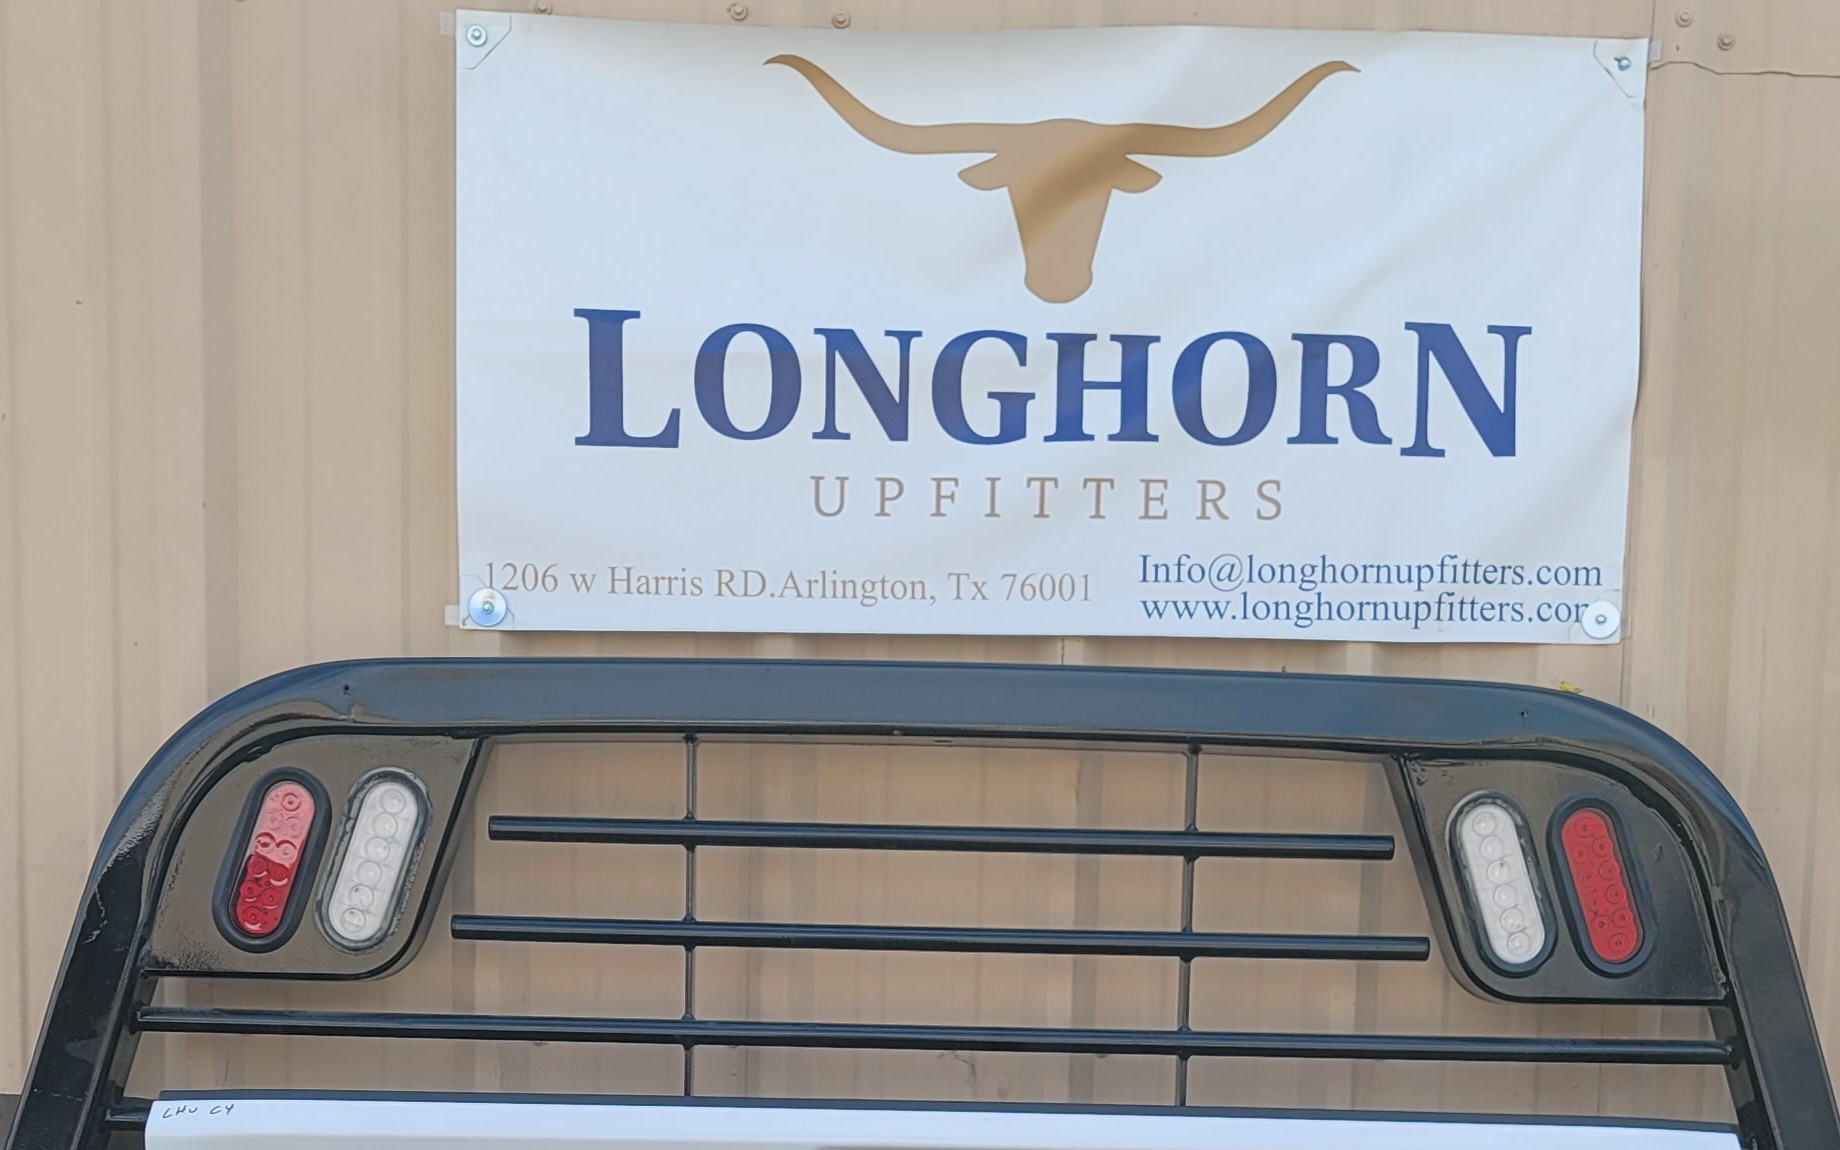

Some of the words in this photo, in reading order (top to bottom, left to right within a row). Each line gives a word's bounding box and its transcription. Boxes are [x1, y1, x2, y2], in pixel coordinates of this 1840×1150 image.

[573, 307, 1532, 458] LONGHORN
[810, 475, 1283, 521] UPFITTERS
[485, 561, 558, 593] 1206
[569, 573, 597, 594] w
[607, 566, 704, 598] Harris
[947, 572, 989, 602] Tx
[1000, 573, 1092, 602] 76001
[1138, 553, 1604, 592] Info@longhornupfitters.com
